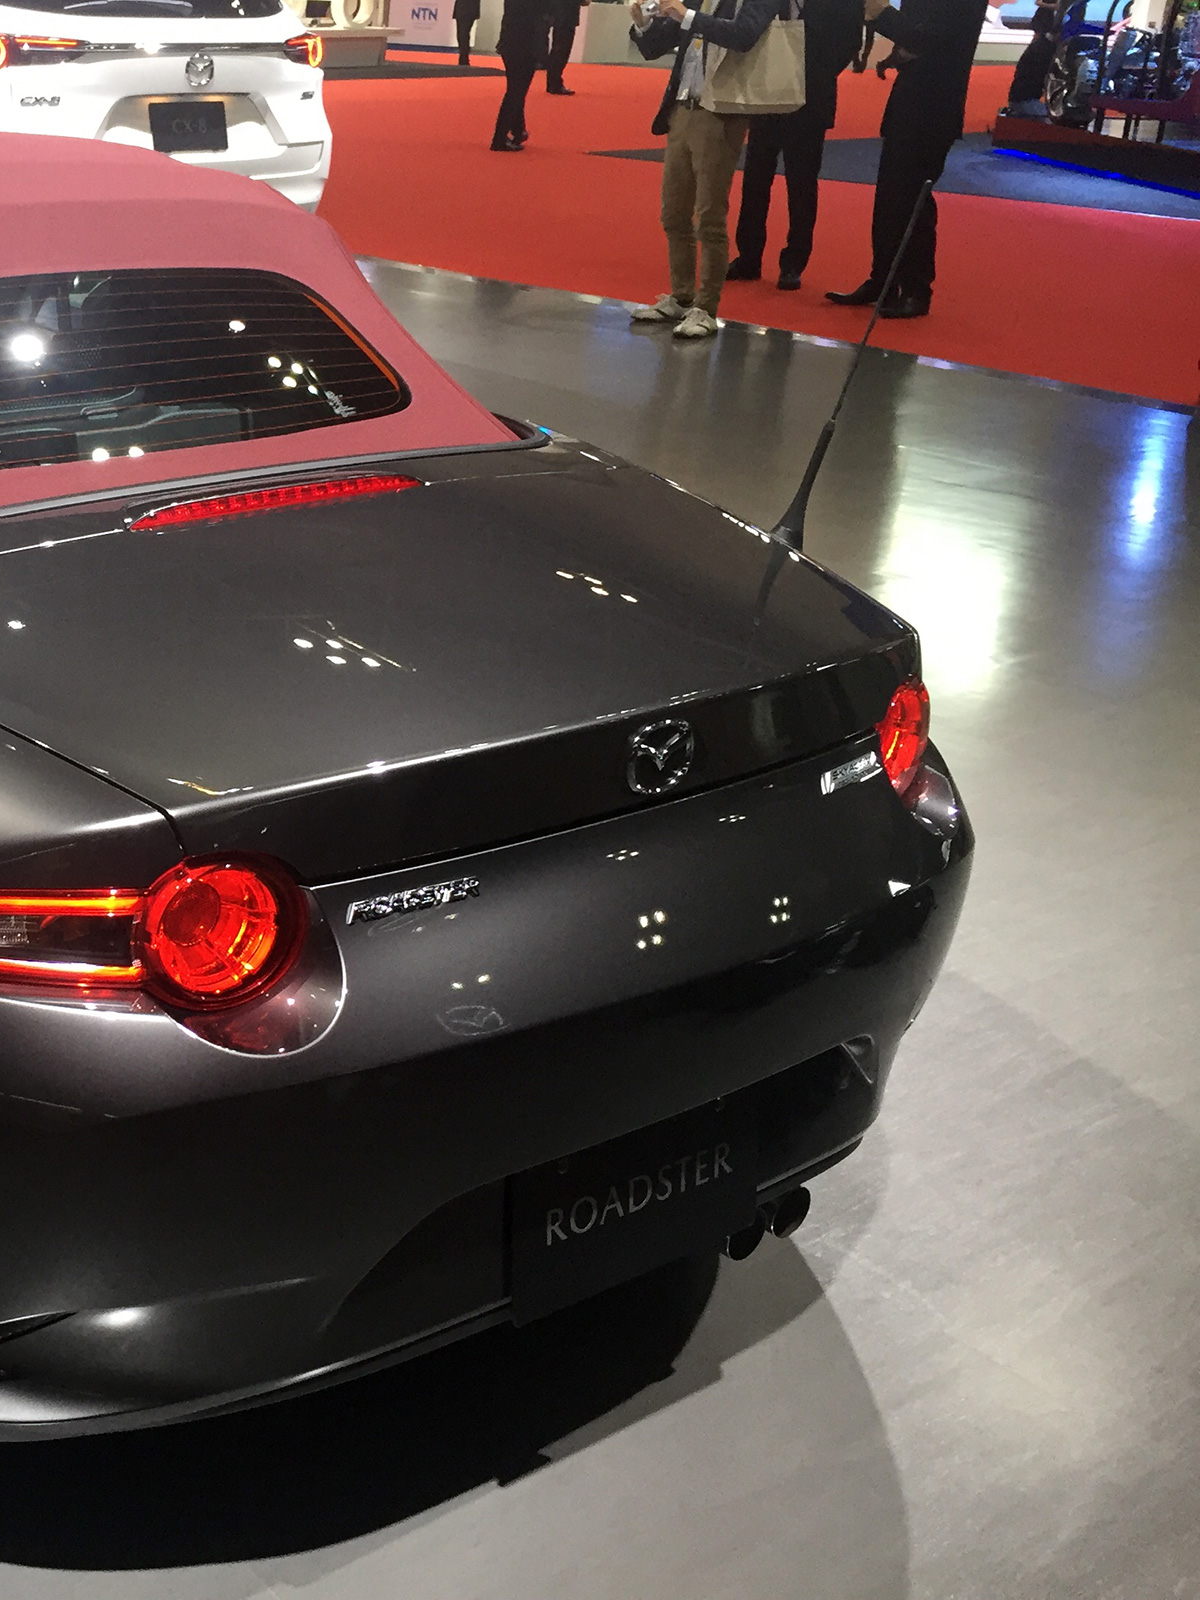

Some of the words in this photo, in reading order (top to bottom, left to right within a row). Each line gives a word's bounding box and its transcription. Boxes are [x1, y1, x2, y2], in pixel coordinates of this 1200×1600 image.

[411, 7, 438, 21] NTN
[171, 117, 208, 134] CX-8
[345, 876, 480, 925] ROADSTER
[546, 1142, 734, 1247] ROADSTER
